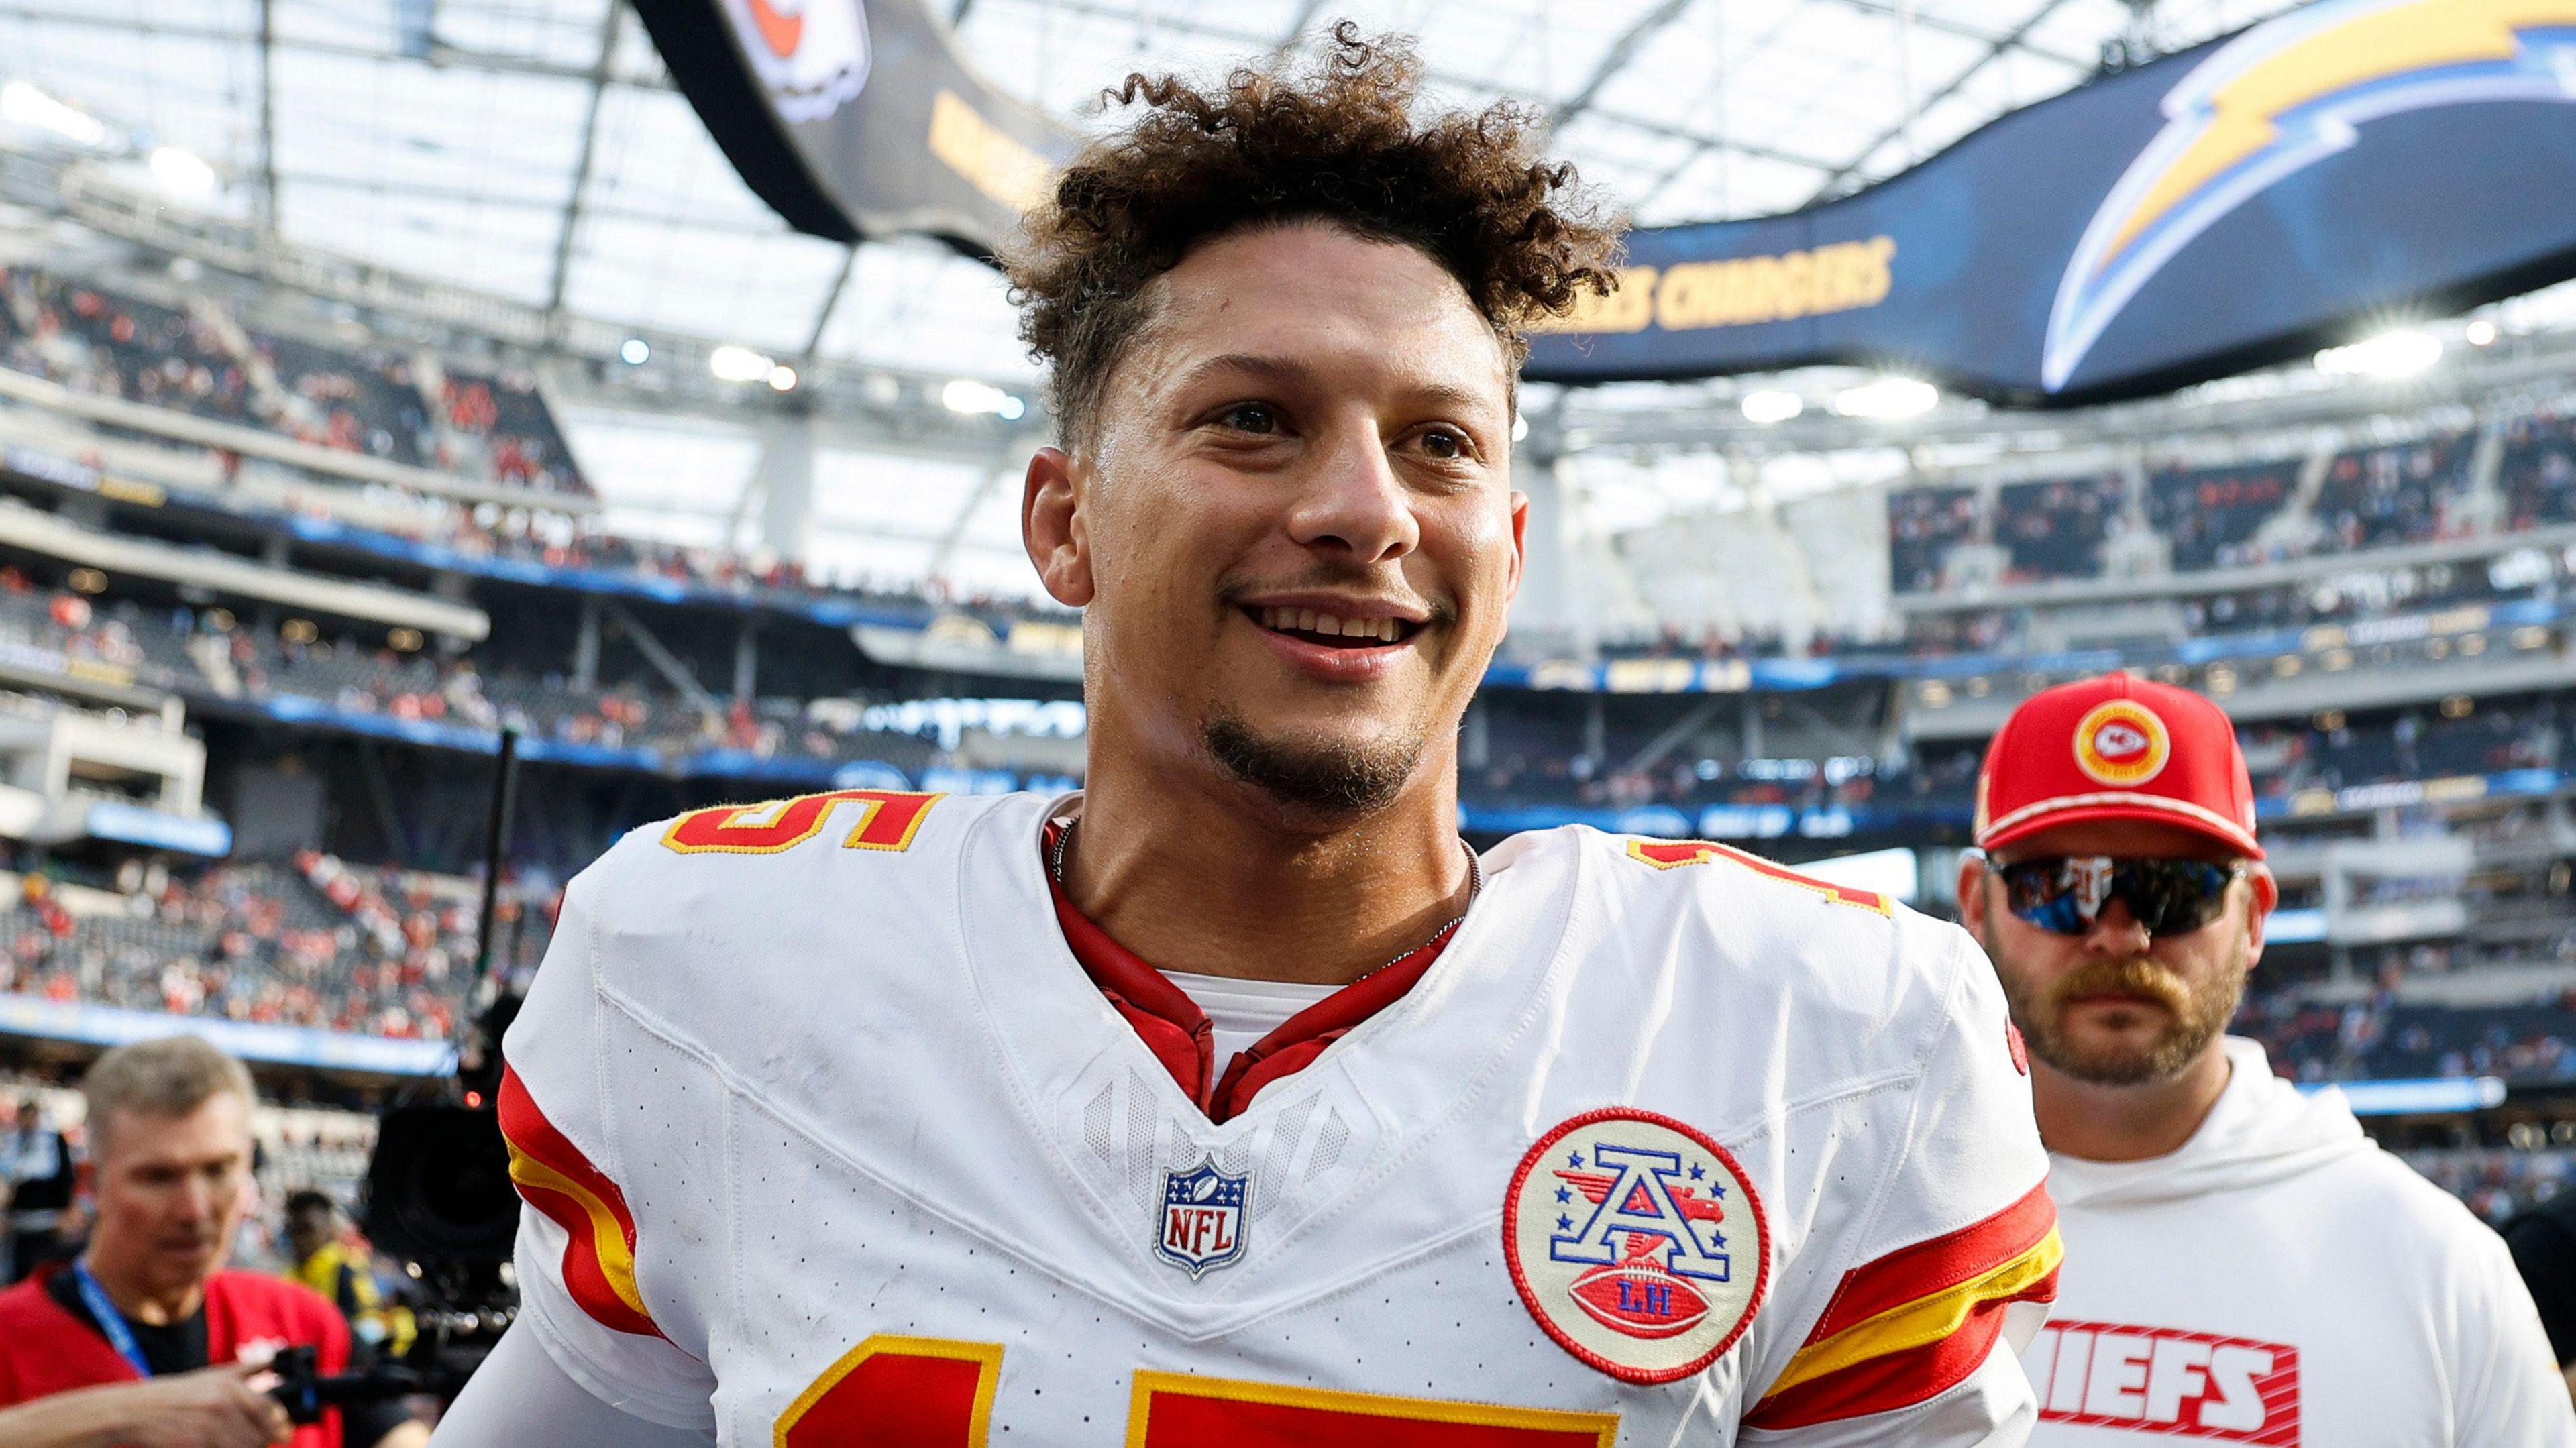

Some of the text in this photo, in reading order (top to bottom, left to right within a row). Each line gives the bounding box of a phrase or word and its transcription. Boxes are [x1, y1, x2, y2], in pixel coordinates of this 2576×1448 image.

[1167, 1208, 1232, 1256] NFL
[1550, 1144, 1731, 1282] A
[1617, 1281, 1672, 1315] LH
